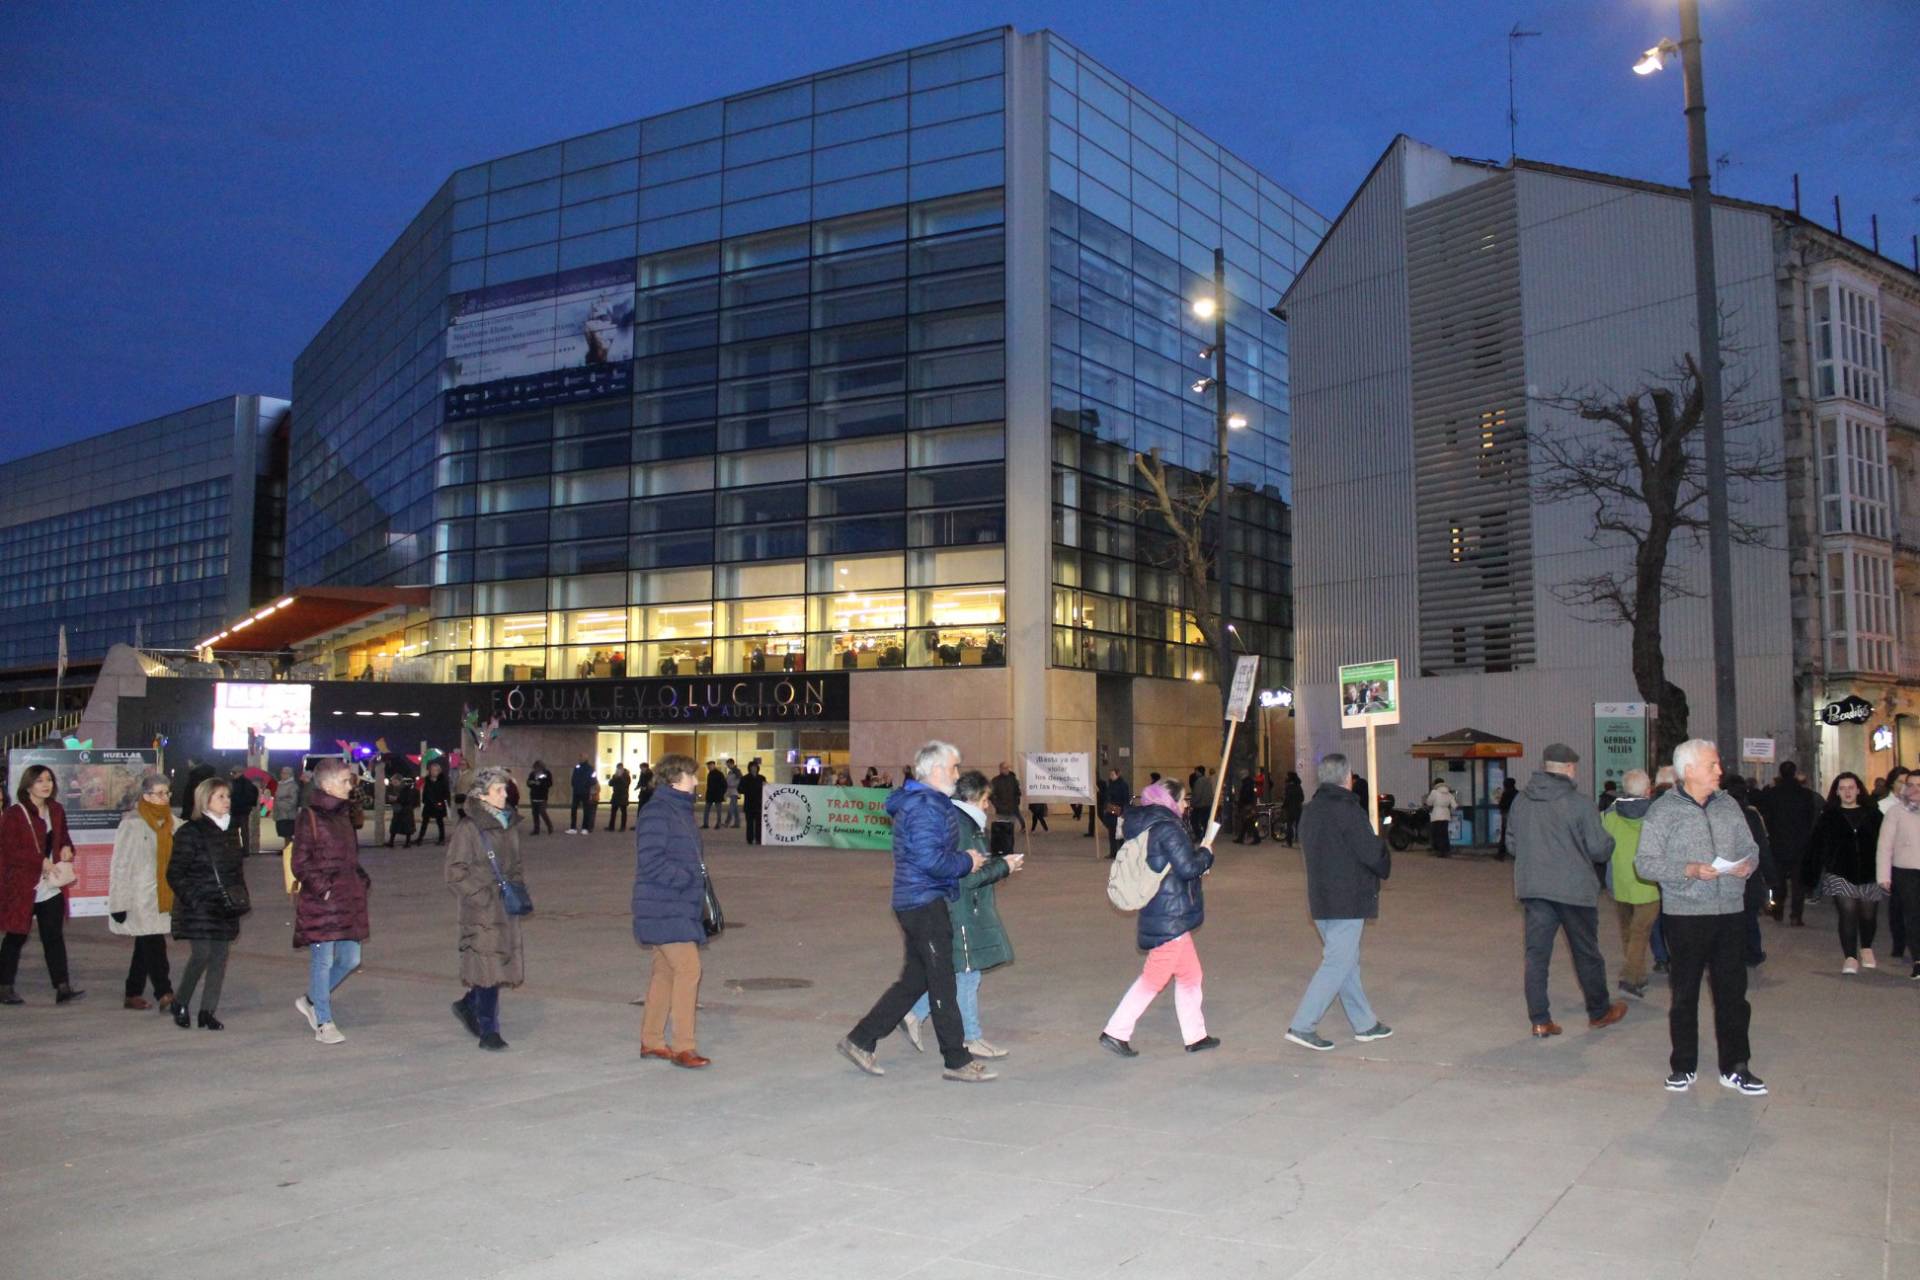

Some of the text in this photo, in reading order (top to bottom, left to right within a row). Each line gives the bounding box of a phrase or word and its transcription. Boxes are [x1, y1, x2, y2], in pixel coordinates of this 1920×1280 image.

[491, 676, 824, 711] FÓRUM EVOLUCIÓN
[702, 704, 709, 718] Y
[721, 702, 823, 718] AUDITORIO
[827, 799, 864, 810] TRATO
[828, 813, 859, 824] PARA
